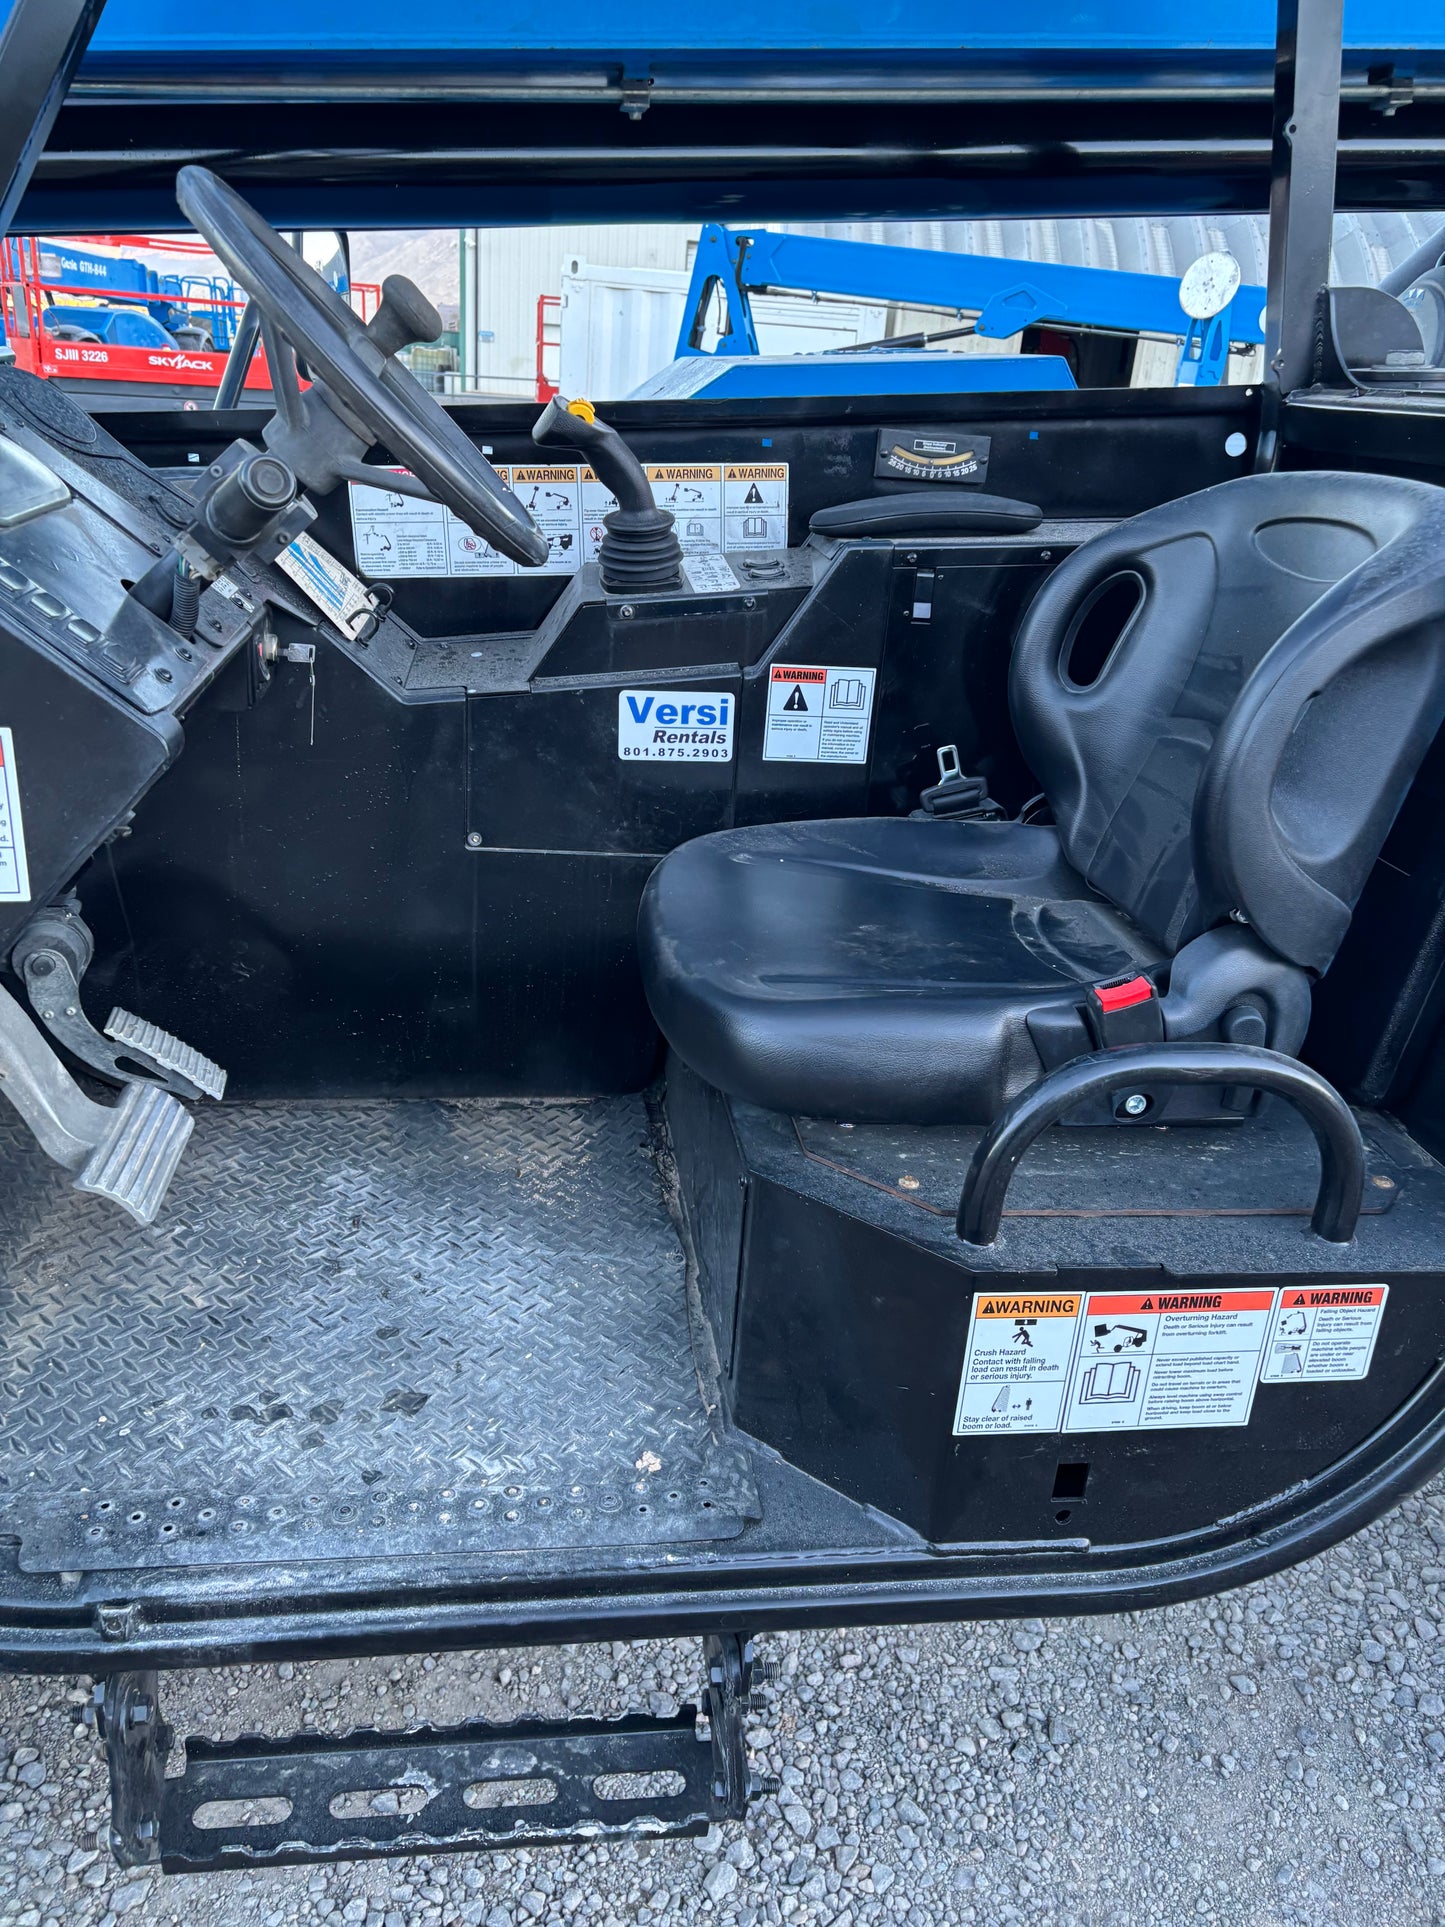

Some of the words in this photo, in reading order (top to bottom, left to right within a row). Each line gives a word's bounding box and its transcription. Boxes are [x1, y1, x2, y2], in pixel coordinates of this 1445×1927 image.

[80, 261, 107, 277] GTH-844
[55, 348, 79, 361] SJIII
[82, 349, 109, 363] 3226
[148, 354, 213, 371] SKYJACK
[526, 469, 574, 480] WARNING
[666, 469, 713, 479] WARNING
[738, 468, 784, 479] WARNING
[783, 670, 824, 680] WARNING
[626, 696, 729, 726] Versi
[653, 730, 727, 744] Rentals
[623, 747, 728, 758] 801.875.2903
[1158, 1295, 1222, 1310] WARNING
[1310, 1291, 1373, 1305] WARNING
[996, 1300, 1074, 1313] WARNING
[1165, 1314, 1209, 1322] Overturning
[999, 1348, 1026, 1356] Hazard
[1023, 1357, 1046, 1365] falling
